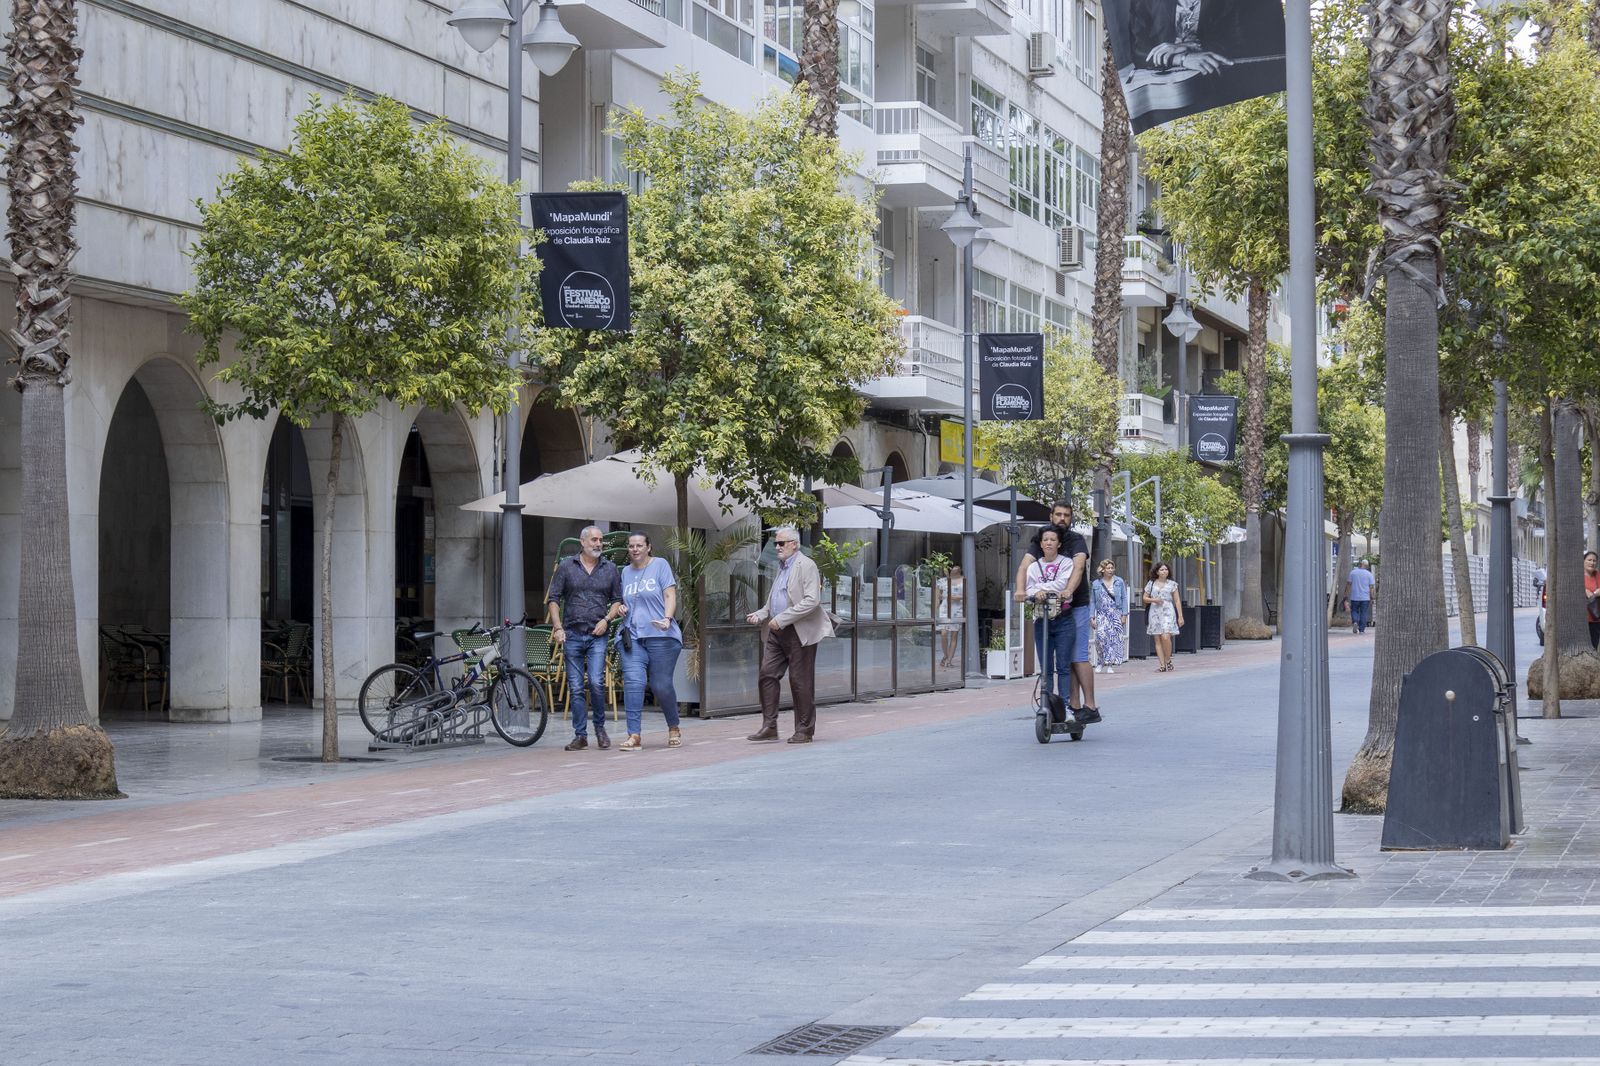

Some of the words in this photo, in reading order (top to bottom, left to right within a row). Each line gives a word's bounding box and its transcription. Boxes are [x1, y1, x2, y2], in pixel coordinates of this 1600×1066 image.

[549, 211, 613, 224] 'MapaMundi'
[582, 225, 620, 236] fotográfica
[553, 237, 563, 245] de
[564, 236, 594, 245] Claudia
[595, 235, 611, 244] Ruiz
[564, 289, 604, 298] FESTIVAL
[565, 296, 611, 305] FLAMENCO
[990, 346, 1034, 354] 'MapaMundi'
[623, 576, 656, 597] nice
